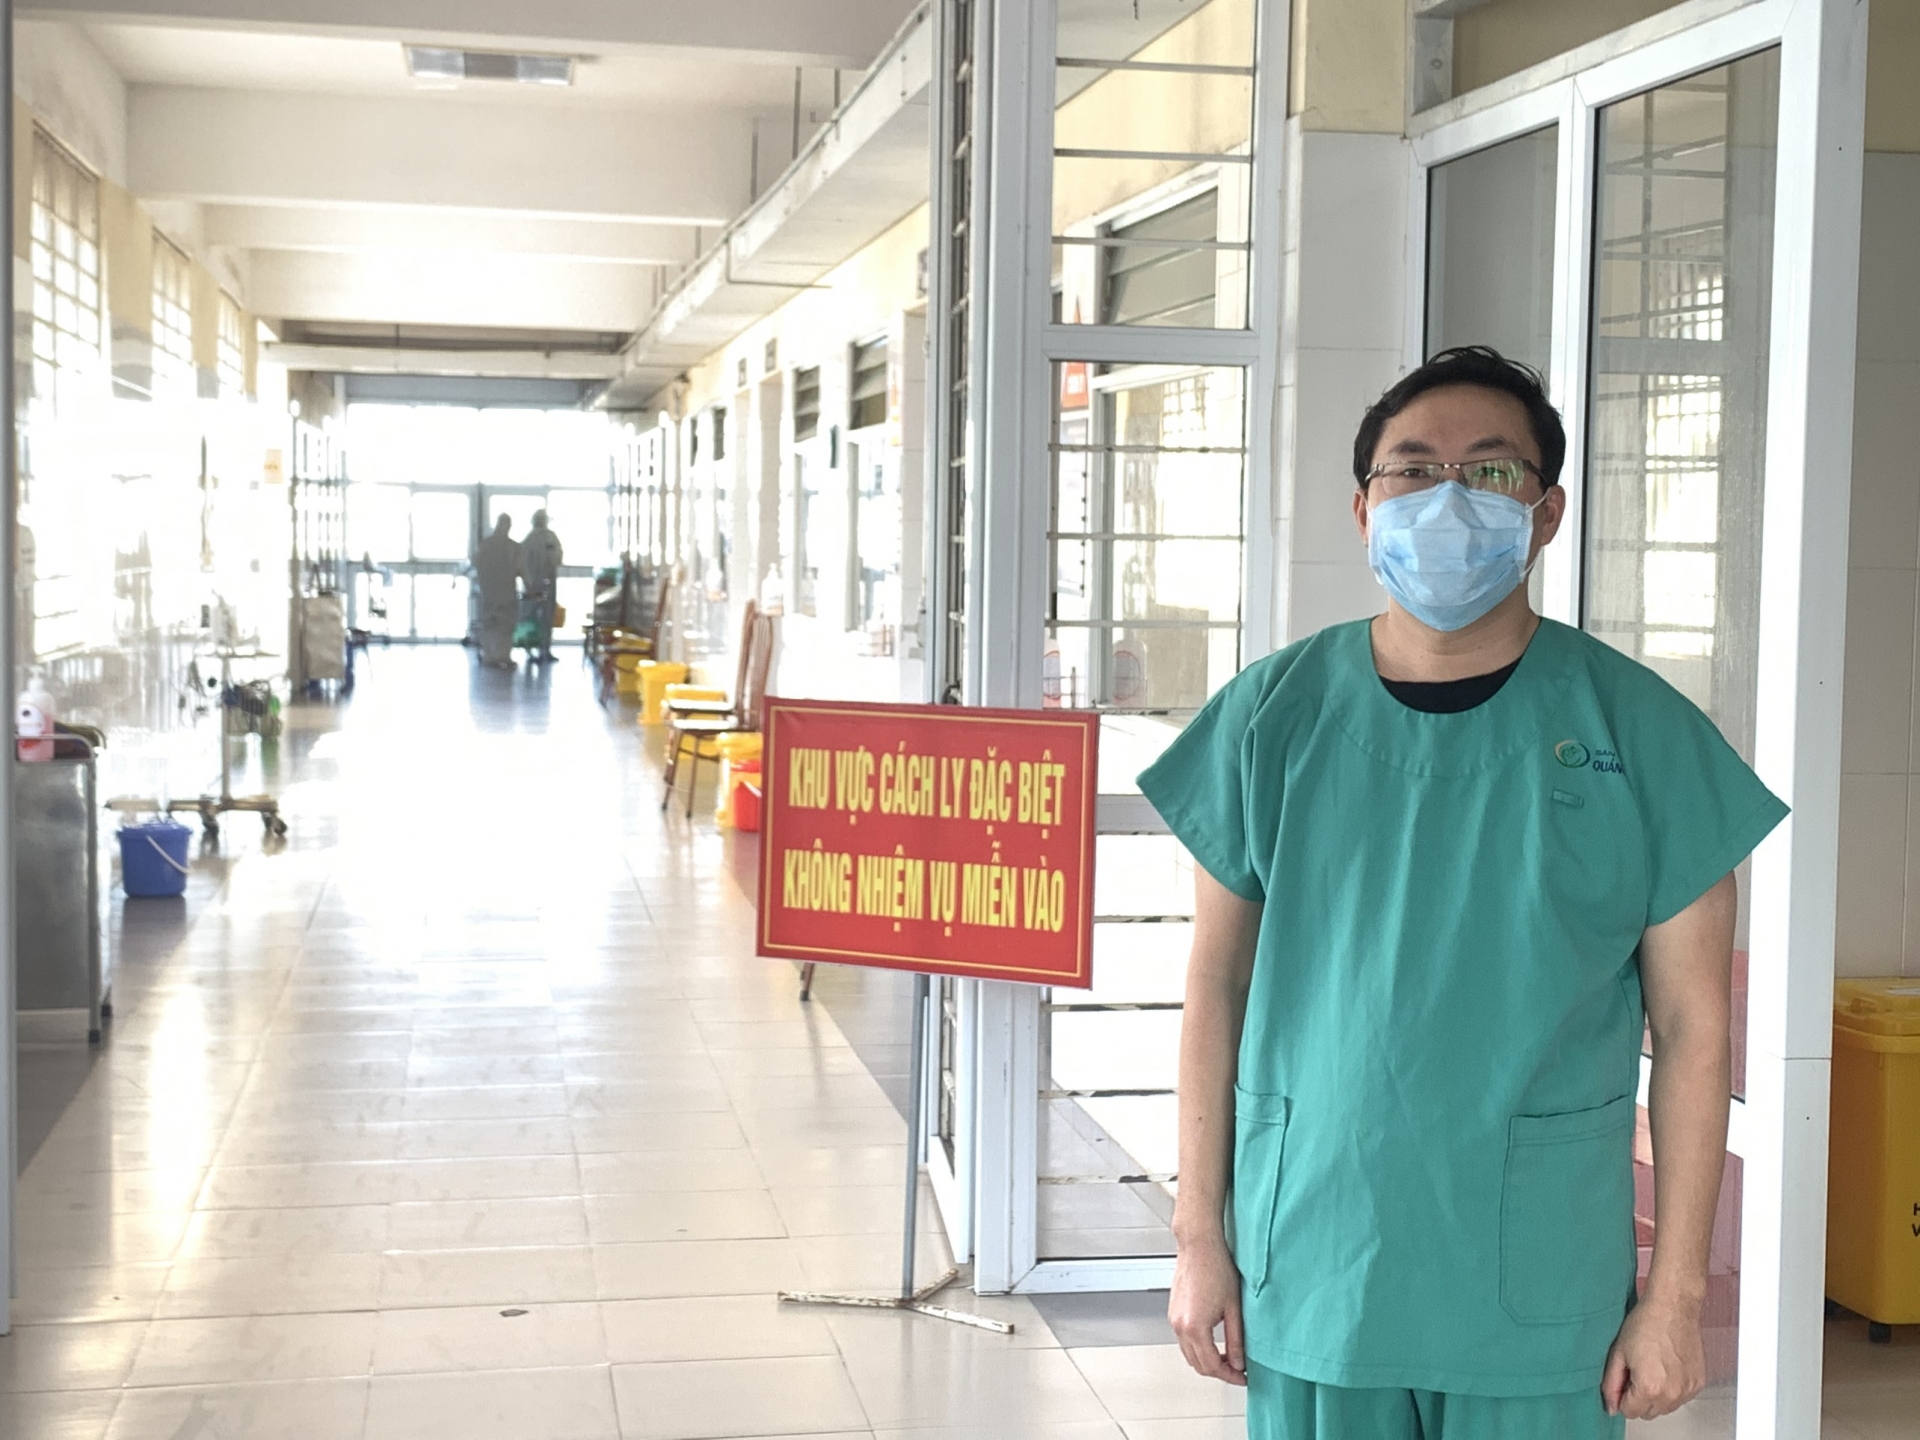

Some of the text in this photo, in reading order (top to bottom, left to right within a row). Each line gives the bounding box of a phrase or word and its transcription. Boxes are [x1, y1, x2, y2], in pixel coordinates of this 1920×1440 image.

[789, 740, 1065, 839] KHU VỰC CÁCH LY ĐẶC BIỆT
[783, 838, 1065, 937] KHÔNG NHIỆM VỤ MIỄN VÀO
